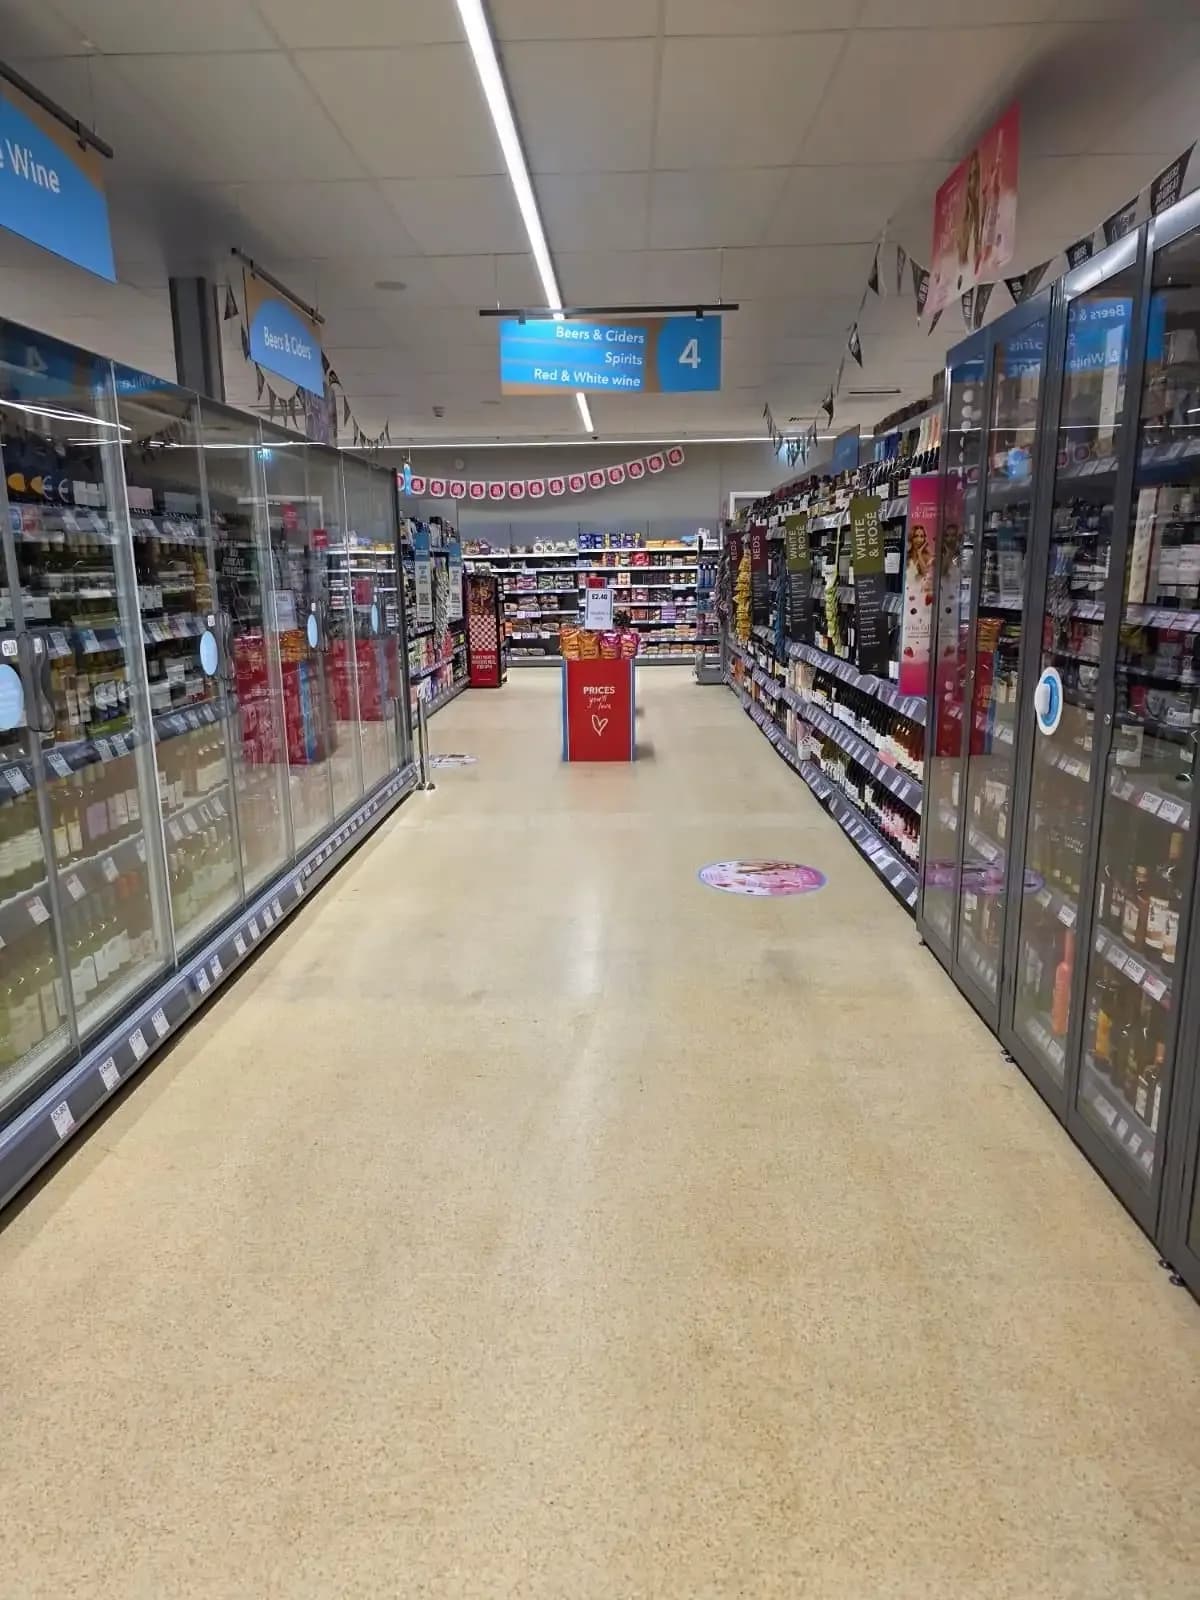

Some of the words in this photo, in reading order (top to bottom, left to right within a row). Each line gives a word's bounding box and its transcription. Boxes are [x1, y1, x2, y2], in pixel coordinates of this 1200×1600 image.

[5, 138, 60, 194] Wine
[263, 326, 284, 350] Beers
[284, 333, 291, 353] &
[291, 336, 312, 361] Ciders
[556, 326, 590, 340] Beers
[593, 328, 602, 341] &
[605, 330, 645, 344] Ciders
[604, 351, 643, 367] Spirits
[678, 338, 701, 369] 4
[534, 367, 557, 381] Red
[561, 369, 570, 382] &
[574, 371, 609, 385] White
[612, 375, 641, 387] wine
[855, 518, 866, 560] WHITE
[867, 511, 879, 543] ROSÉ
[788, 529, 797, 560] WHITE
[869, 548, 879, 558] &
[583, 686, 616, 695] PRICES
